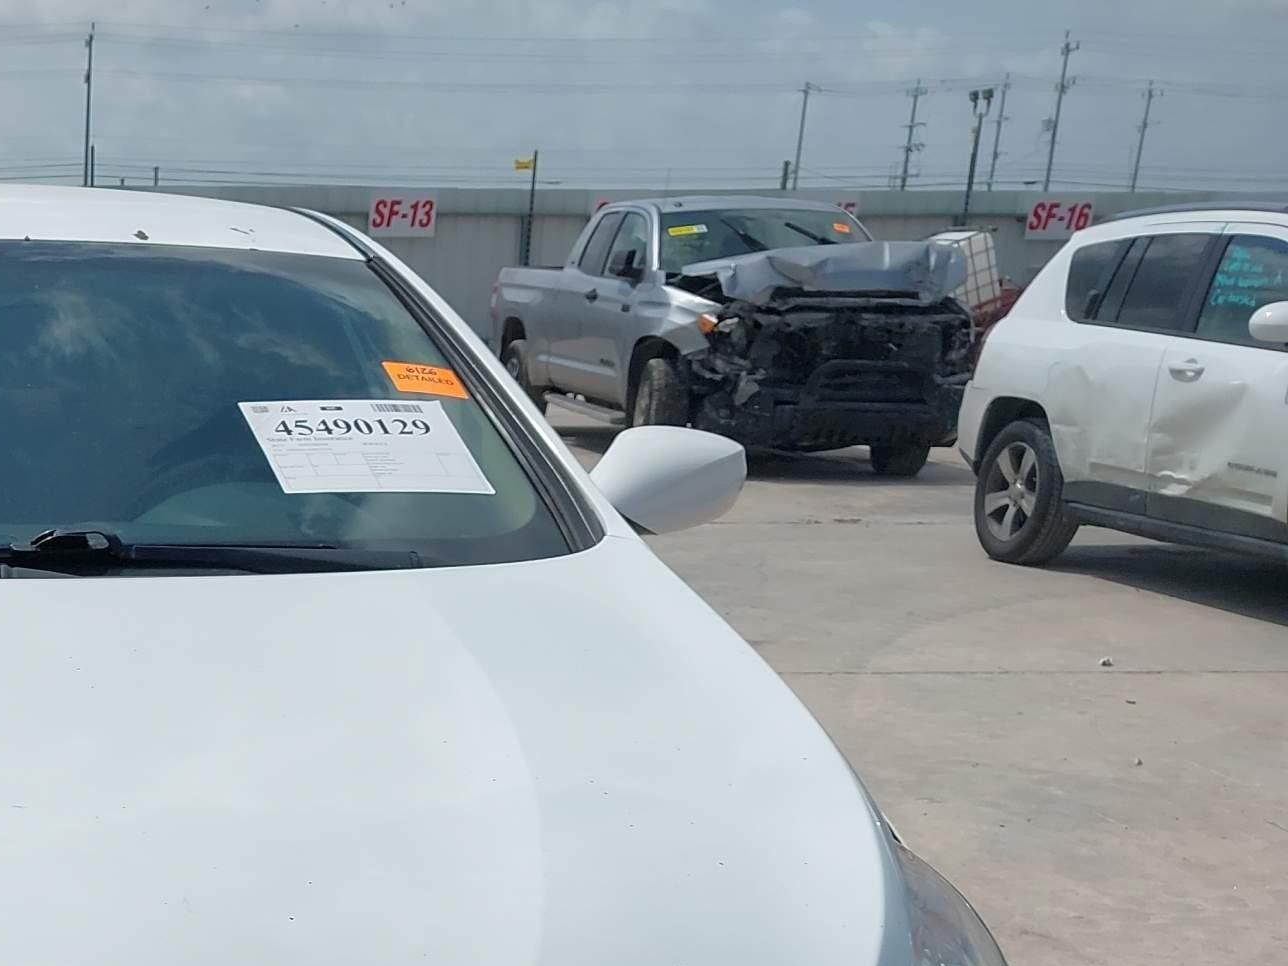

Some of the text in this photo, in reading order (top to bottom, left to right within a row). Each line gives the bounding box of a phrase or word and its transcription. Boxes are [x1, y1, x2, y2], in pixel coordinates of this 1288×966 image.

[371, 199, 434, 229] SF-13
[1028, 202, 1093, 231] SF-16
[274, 418, 431, 437] 45490129
